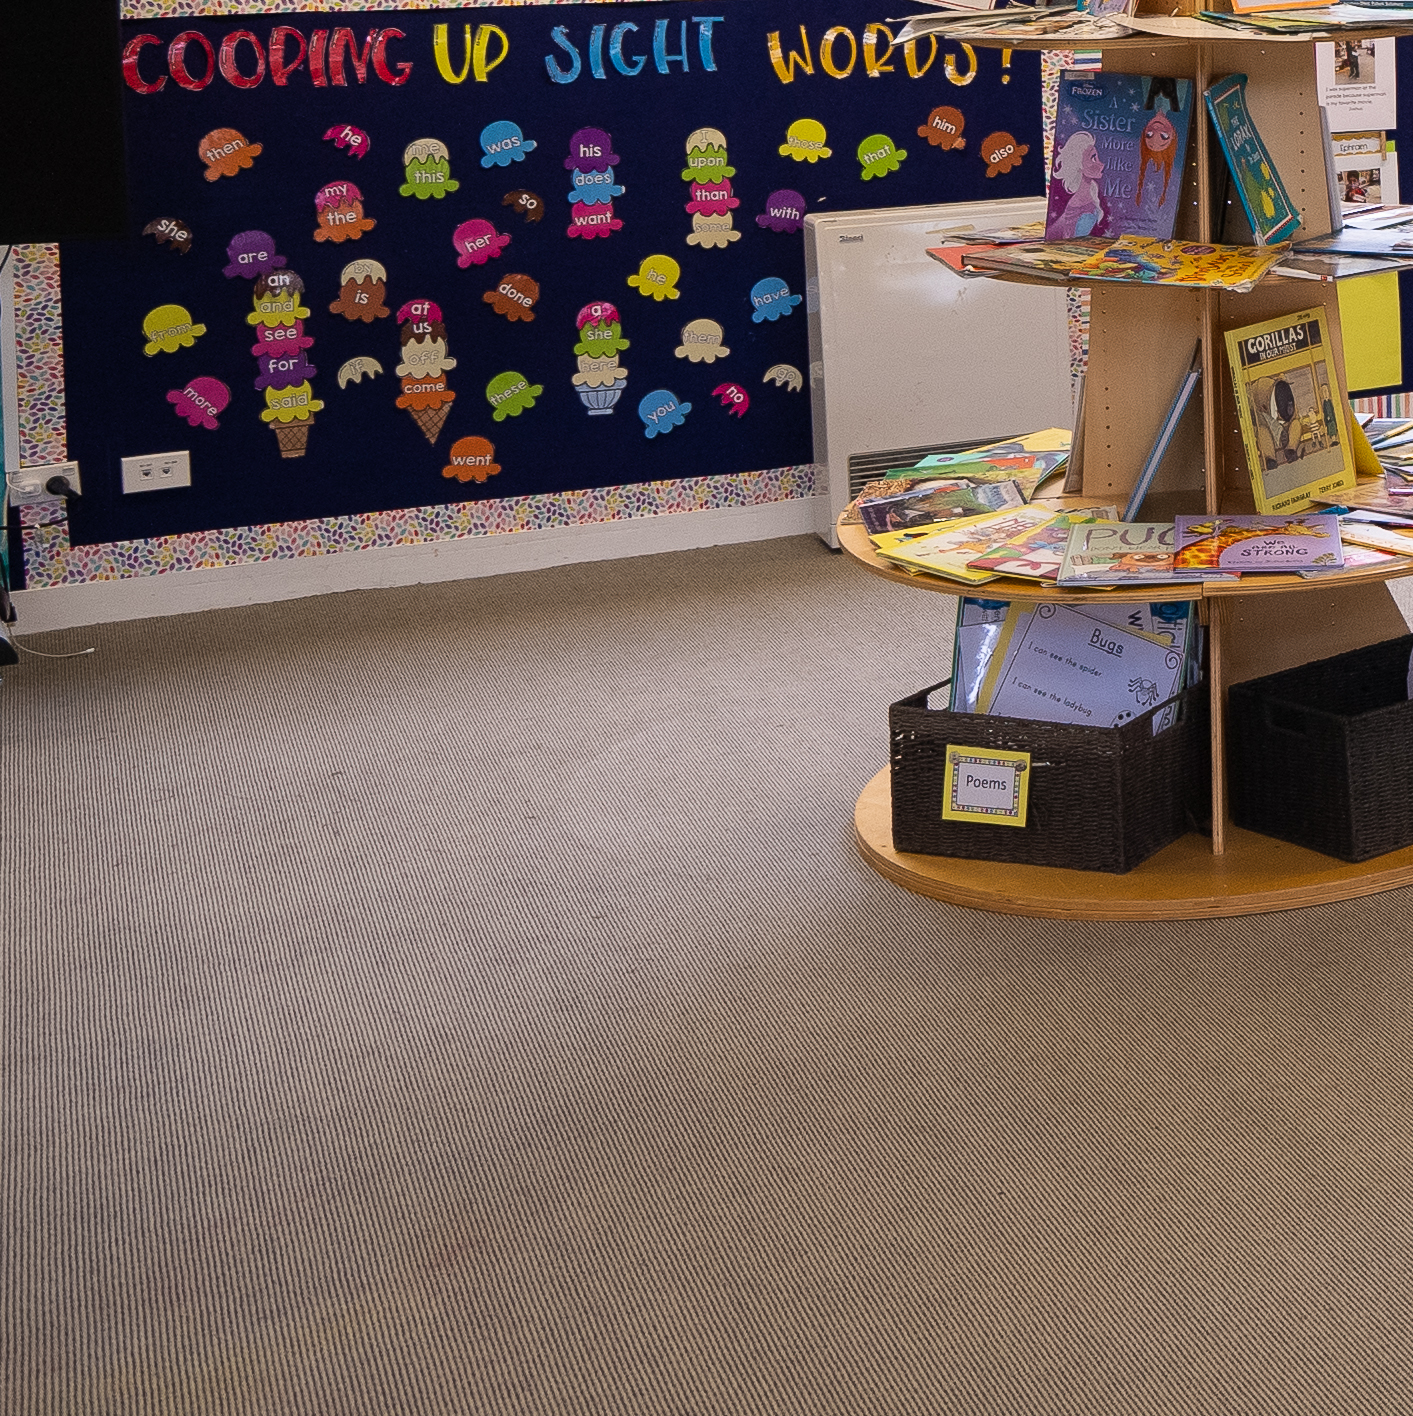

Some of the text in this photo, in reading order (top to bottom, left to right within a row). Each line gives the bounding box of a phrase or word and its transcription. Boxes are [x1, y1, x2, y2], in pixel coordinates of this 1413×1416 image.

[122, 26, 412, 94] COOPING
[433, 23, 508, 83] UP
[545, 16, 724, 84] SIGHT
[1072, 86, 1102, 97] FROZEN
[932, 116, 956, 135] him
[1082, 109, 1135, 132] Sister
[341, 125, 362, 146] he
[206, 138, 244, 162] then
[486, 136, 521, 154] was
[579, 144, 602, 158] his
[1101, 136, 1134, 151] More
[1340, 143, 1368, 152] Ephraim
[863, 144, 891, 164] that
[990, 145, 1014, 164] also
[690, 155, 724, 169] upon
[1107, 157, 1132, 172] Like
[414, 170, 445, 184] this
[575, 171, 612, 185] does
[324, 184, 348, 198] my
[696, 188, 728, 202] than
[1103, 182, 1131, 199] Me
[518, 194, 537, 210] so
[327, 211, 357, 226] the
[575, 211, 612, 225] want
[770, 206, 799, 221] with
[156, 219, 188, 242] she
[465, 233, 492, 253] her
[238, 249, 268, 263] are
[268, 275, 290, 286] an
[647, 268, 666, 285] he
[355, 290, 369, 304] is
[499, 284, 533, 307] done
[754, 286, 790, 307] have
[265, 327, 298, 340] see
[413, 322, 432, 333] us
[587, 329, 612, 340] she
[1248, 325, 1304, 353] GORILLAS
[1260, 343, 1297, 360] IN OUR MIDST
[268, 358, 298, 372] for
[404, 382, 445, 393] come
[727, 386, 744, 403] no
[182, 386, 218, 417] more
[648, 400, 675, 424] you
[452, 453, 492, 466] went
[1241, 546, 1308, 557] STRONG
[1090, 628, 1124, 655] Bugs
[966, 774, 1007, 790] Poems
